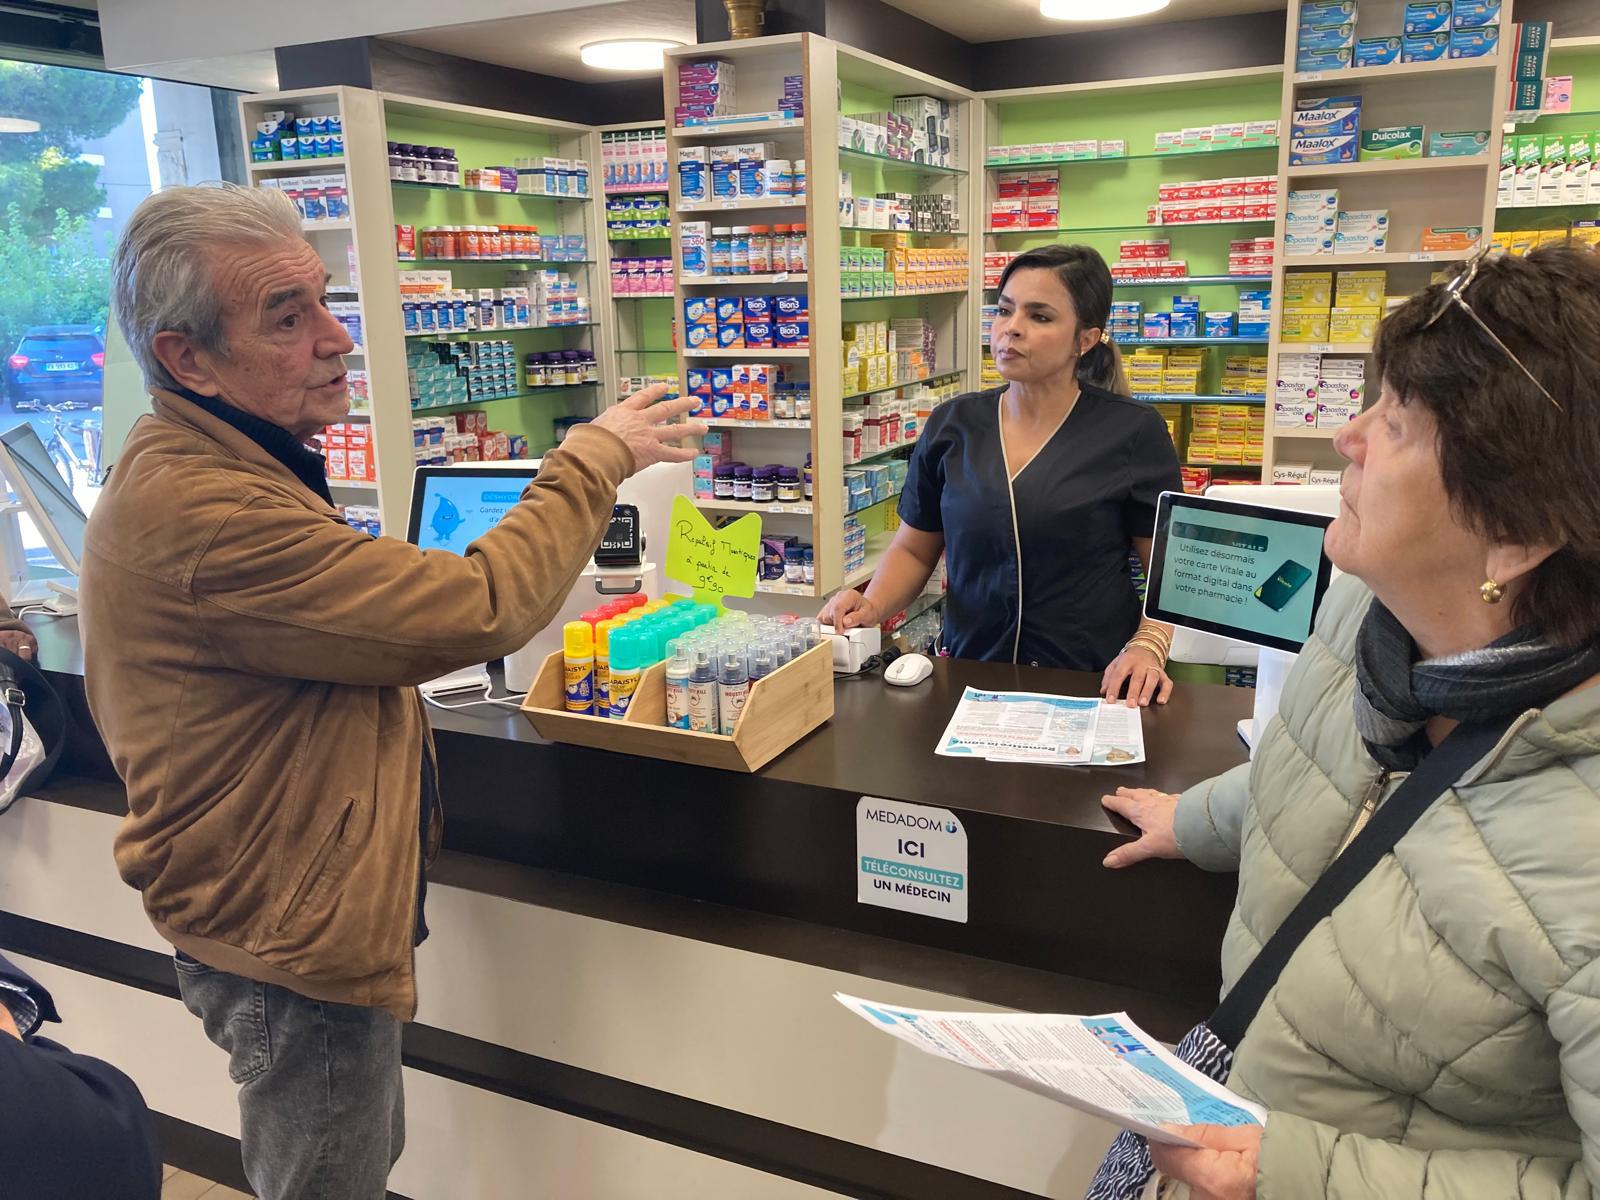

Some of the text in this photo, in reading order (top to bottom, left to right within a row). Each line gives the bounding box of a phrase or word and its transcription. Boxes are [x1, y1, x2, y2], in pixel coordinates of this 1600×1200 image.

[1297, 110, 1339, 122] Maalox
[1372, 130, 1411, 141] Dulcolax
[1296, 138, 1337, 149] Maalox
[690, 237, 704, 246] 360
[748, 298, 766, 310] Bion3
[780, 299, 800, 310] Bion3
[750, 326, 768, 335] Bion3
[780, 326, 800, 335] Bion3
[1273, 470, 1307, 480] Cys-Régul
[1311, 477, 1339, 485] Cys-Régul
[1179, 543, 1209, 556] Utilisez
[1174, 557, 1257, 579] votre carte Vitale au
[1174, 568, 1253, 592] format digital dans
[1175, 583, 1197, 595] votre
[1198, 586, 1244, 605] pharmacie
[866, 809, 943, 832] MEDADOM
[898, 838, 925, 858] ICI
[864, 860, 960, 888] TÉLÉCONSULTEZ
[873, 878, 951, 904] UN MÉDECIN
